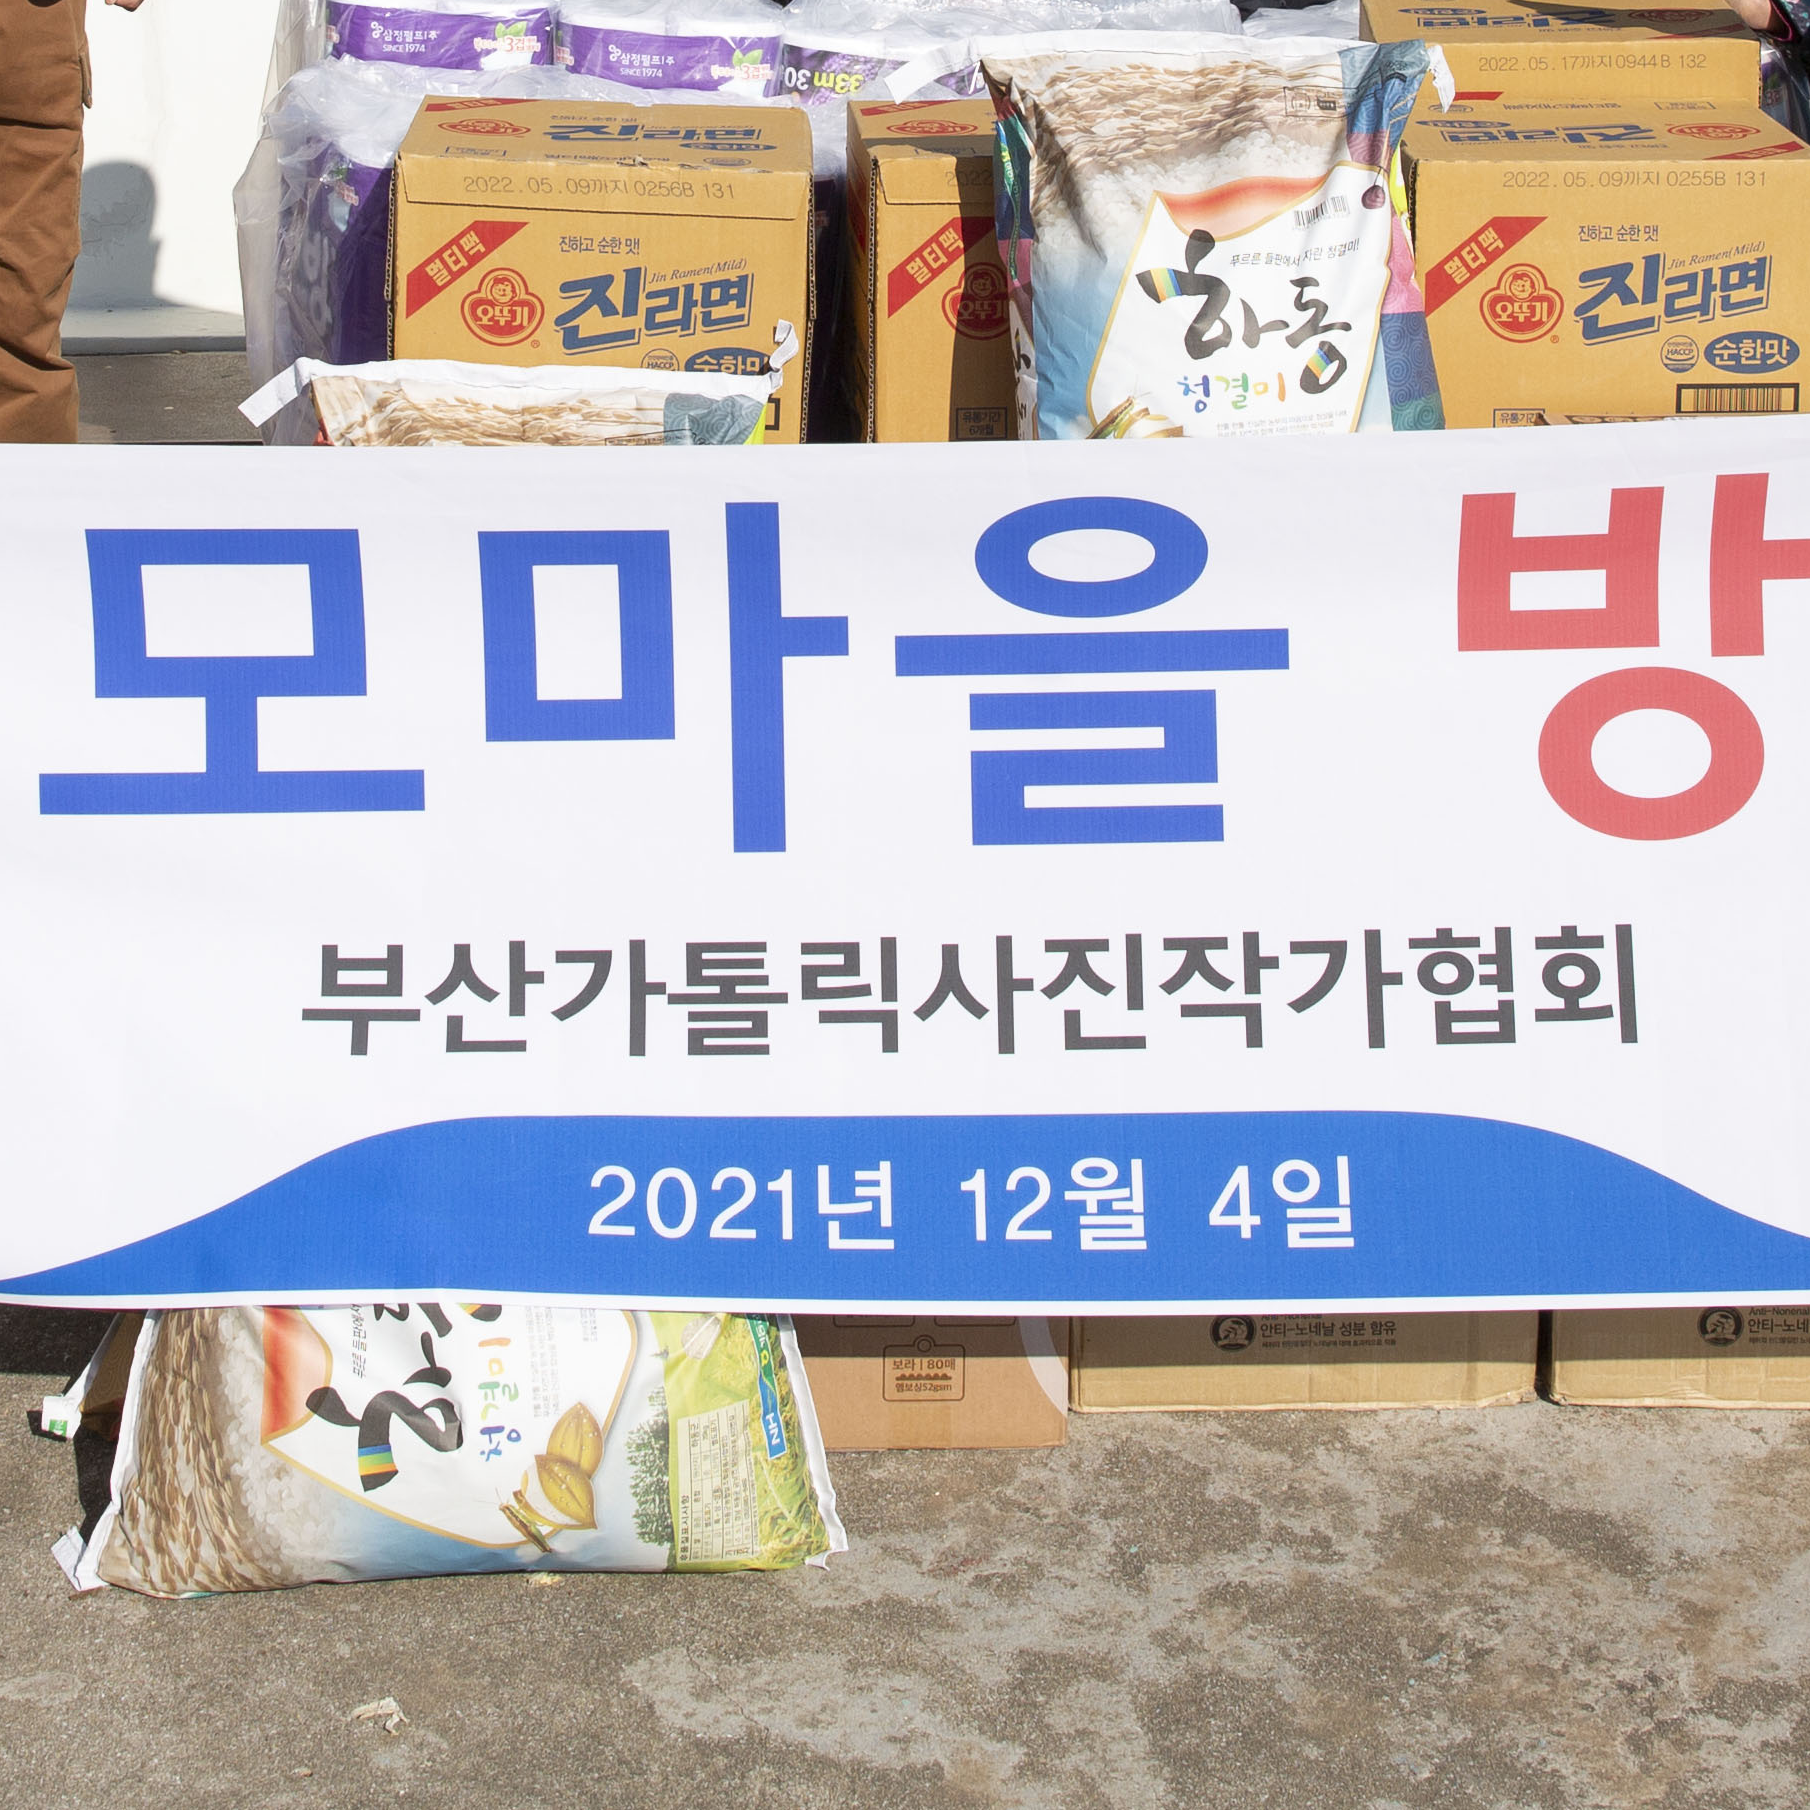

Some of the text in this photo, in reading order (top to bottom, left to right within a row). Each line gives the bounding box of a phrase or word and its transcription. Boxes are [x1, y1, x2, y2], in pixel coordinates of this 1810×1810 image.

[383, 44, 426, 53] SINCE 1974
[620, 68, 663, 78] SINCE 1974
[1678, 54, 1708, 69] 132
[813, 72, 864, 94] 33m
[703, 183, 735, 200] 131
[1735, 171, 1768, 188] 131
[559, 235, 594, 253] 진하고
[597, 236, 622, 255] 순한
[1578, 224, 1613, 242] 진하고
[1616, 224, 1641, 242] 순한
[425, 230, 487, 287] 멀티팩
[905, 227, 966, 286] 멀티팩
[1443, 226, 1506, 284] 멀티팩
[1667, 240, 1766, 270] Jin Ramen(Mild)
[648, 257, 748, 285] Jin Ramen(Mild)
[1573, 242, 1773, 347] 진라면
[476, 303, 530, 328] 오뚜기
[554, 266, 755, 356] 진라면
[958, 299, 1010, 321] 오뚜기
[1135, 228, 1353, 395] 하동
[1494, 299, 1549, 323] 오뚜기
[1666, 348, 1694, 356] HACCP
[1713, 338, 1791, 366] 순한맛
[647, 361, 674, 370] HACCP
[1176, 372, 1287, 414] 청결미
[301, 924, 1638, 1057] 부산가톨릭사진작가협회
[588, 1155, 1355, 1250] 2021년 12월 4일
[1261, 1320, 1397, 1338] 안티-노네날 성분 함유
[892, 1358, 957, 1372] 보라 80매
[477, 1335, 522, 1463] 청결미
[765, 1412, 781, 1446] NH
